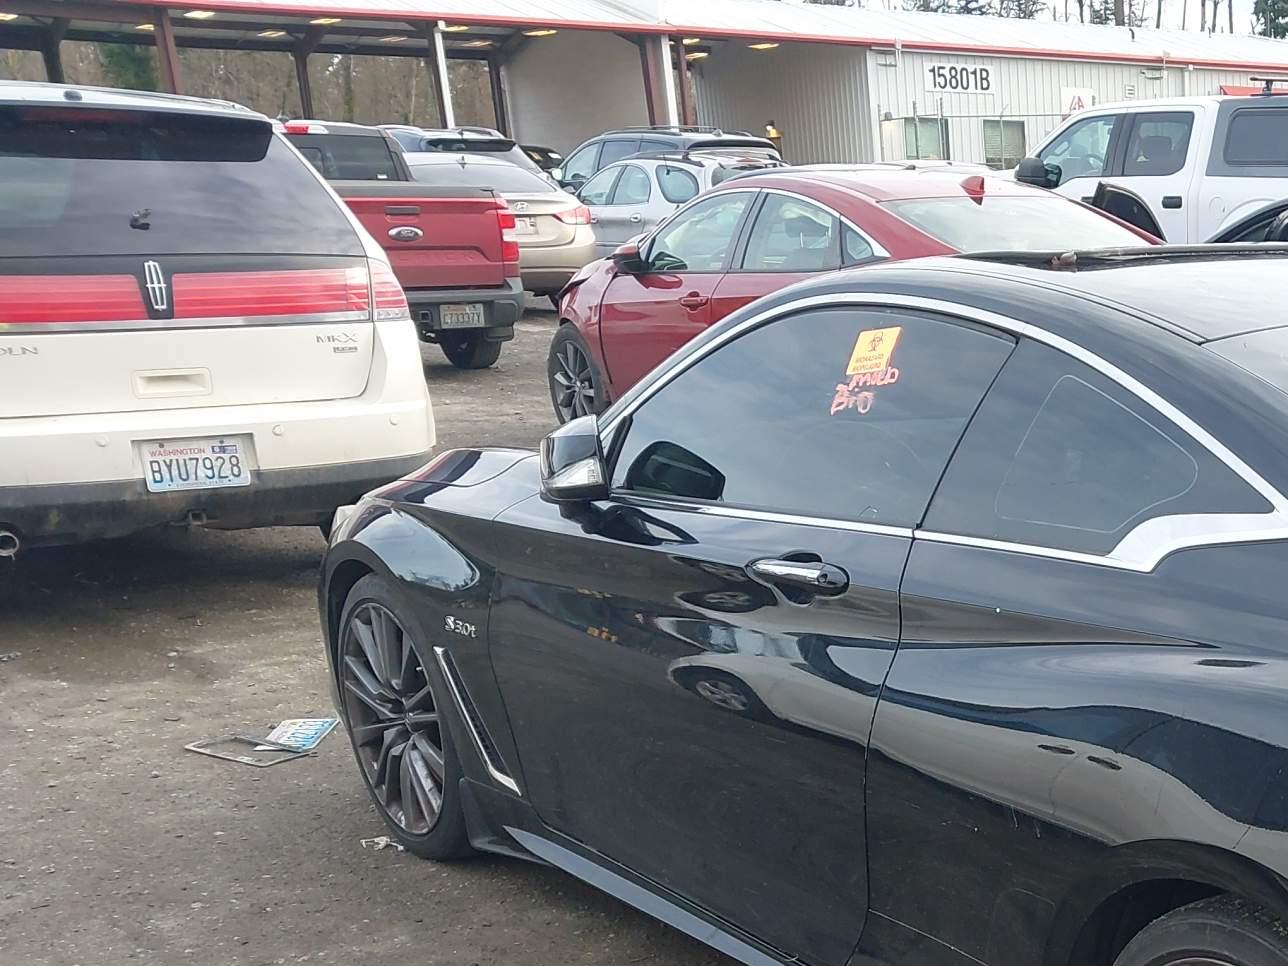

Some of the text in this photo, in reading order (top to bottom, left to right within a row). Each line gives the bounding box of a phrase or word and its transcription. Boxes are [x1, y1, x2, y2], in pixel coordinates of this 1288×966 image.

[928, 65, 990, 91] 15801B
[316, 332, 358, 343] MKX
[149, 447, 206, 458] WASHINGTON
[149, 455, 242, 484] BYU7928
